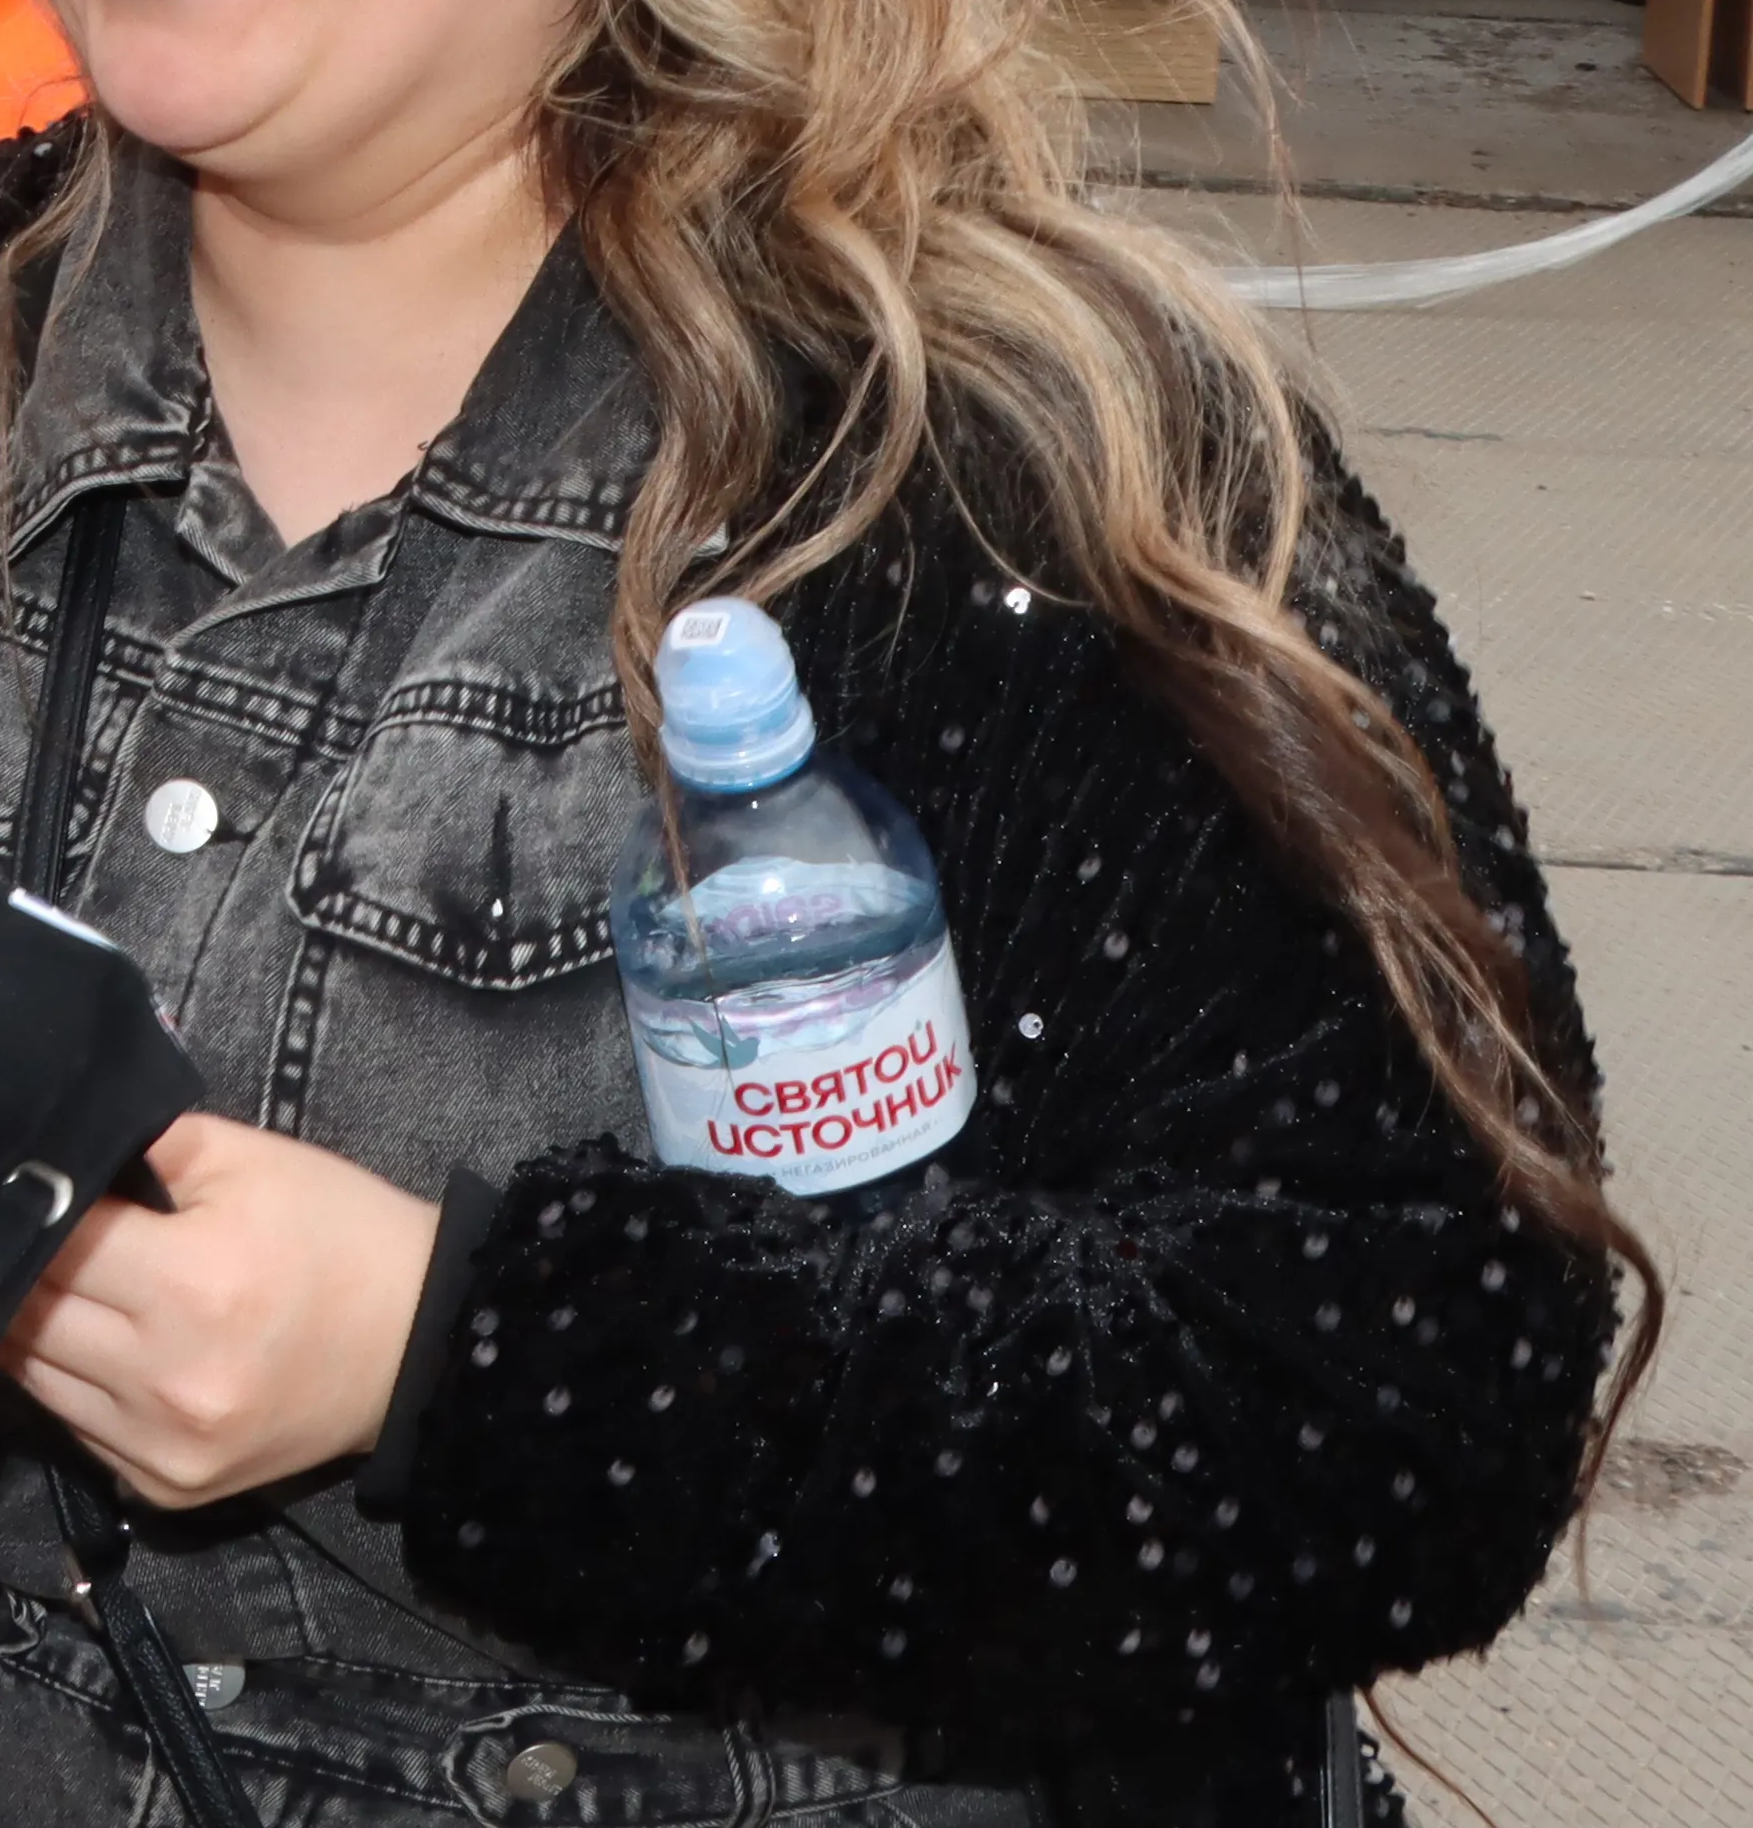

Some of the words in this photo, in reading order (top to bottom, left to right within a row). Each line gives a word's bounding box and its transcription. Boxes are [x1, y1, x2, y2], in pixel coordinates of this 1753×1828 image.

[707, 1040, 963, 1159] ИСТОЧНИК
[733, 1018, 938, 1117] СВЯТОЙ
[781, 1122, 933, 1178] НЕГАЗИРОВАННАЯ
